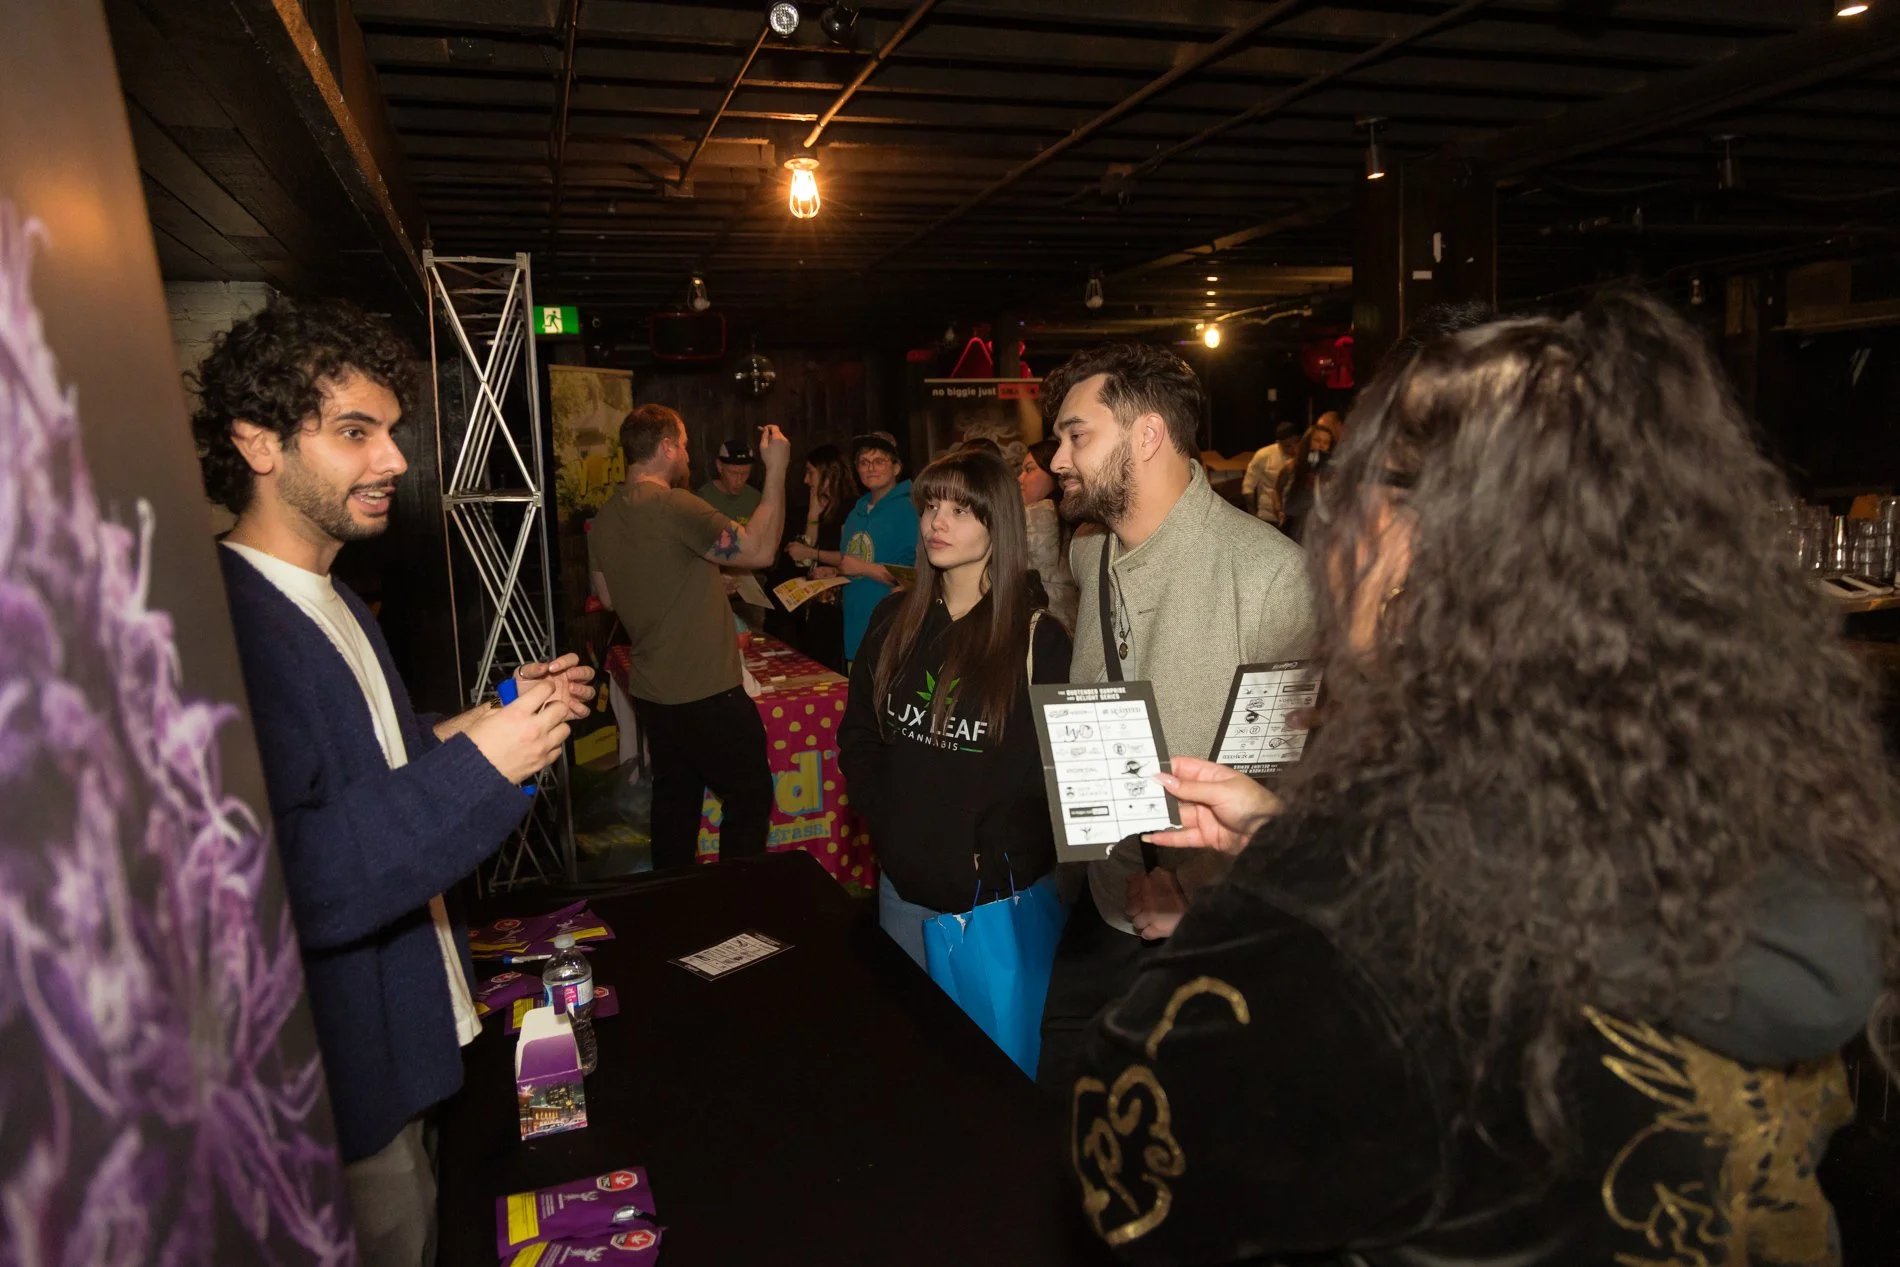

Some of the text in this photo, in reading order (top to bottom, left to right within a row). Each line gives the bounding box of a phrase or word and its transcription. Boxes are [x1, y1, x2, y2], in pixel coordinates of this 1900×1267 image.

[931, 388, 945, 397] no
[947, 386, 976, 398] biggie
[978, 387, 997, 398] just
[930, 713, 988, 742] LEAF
